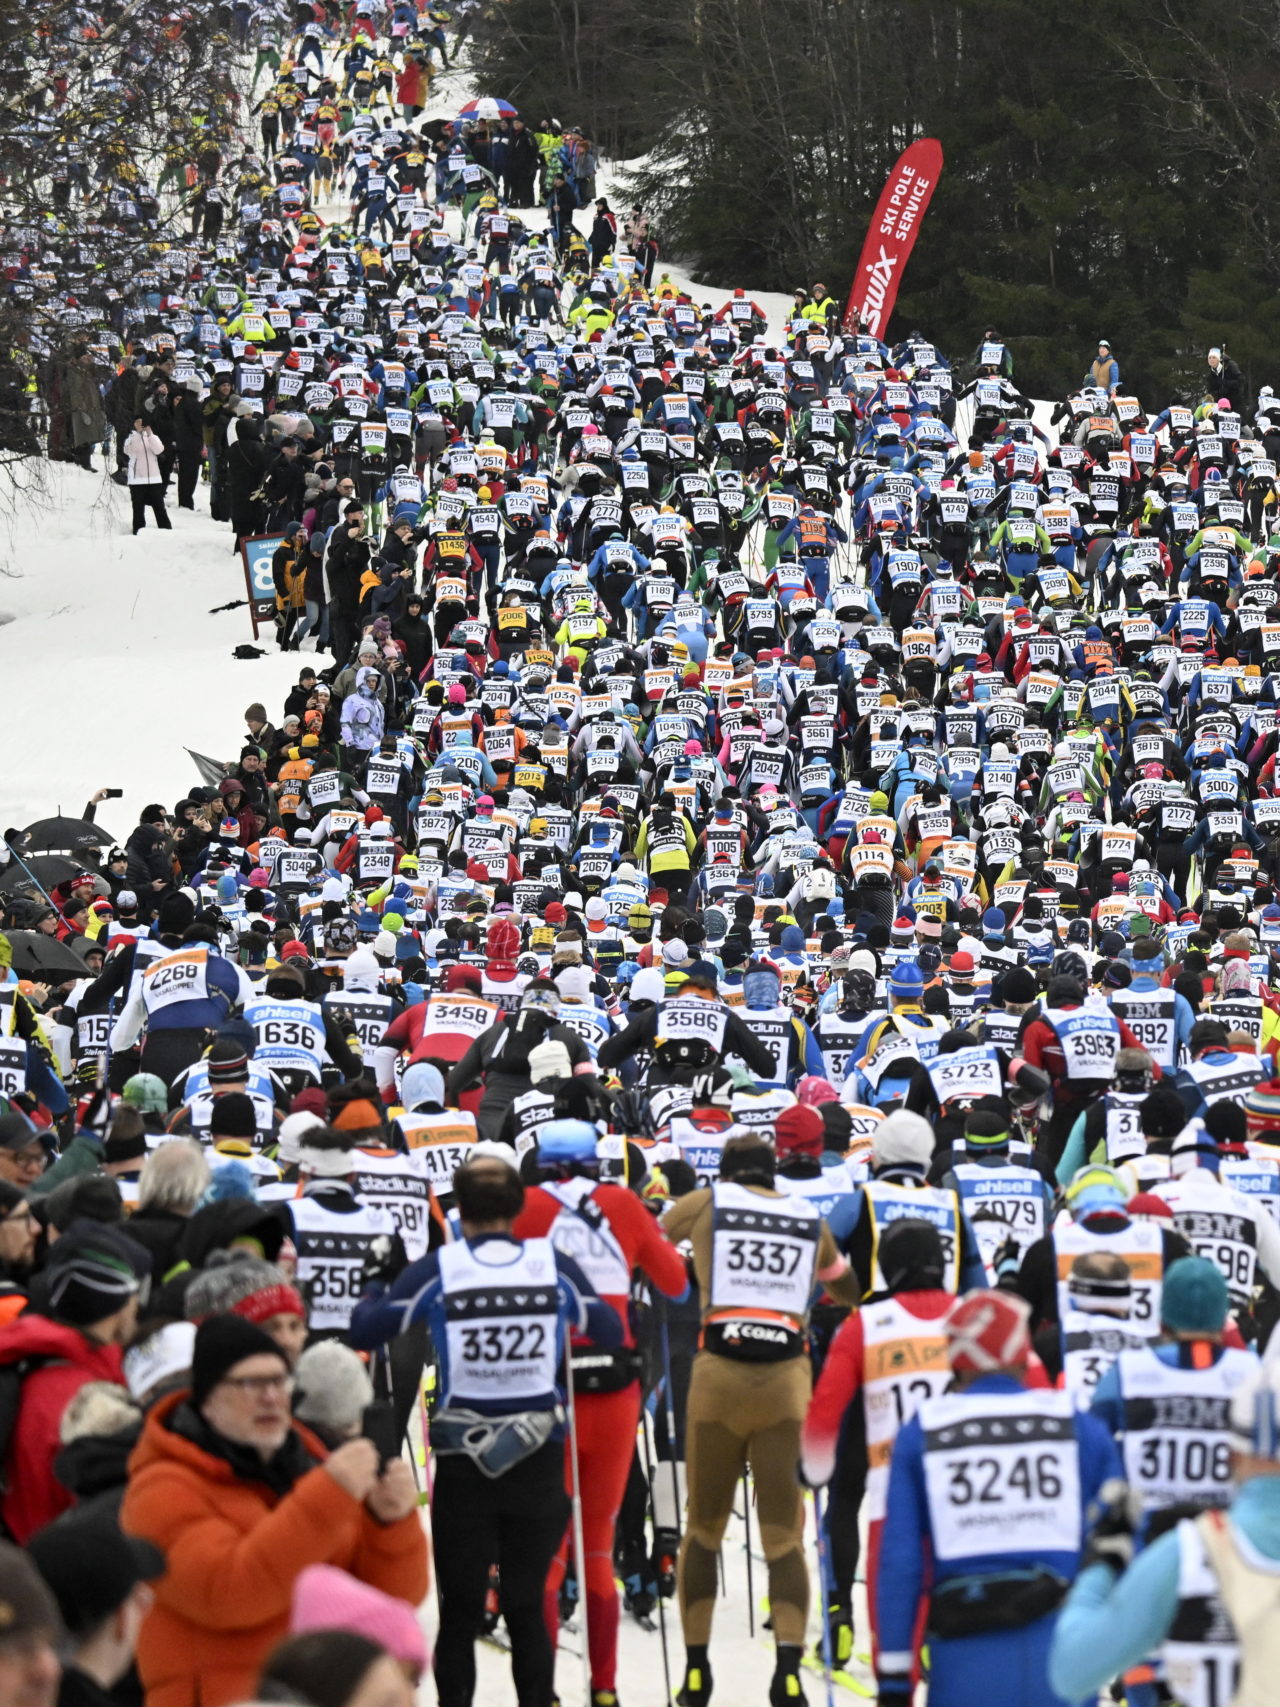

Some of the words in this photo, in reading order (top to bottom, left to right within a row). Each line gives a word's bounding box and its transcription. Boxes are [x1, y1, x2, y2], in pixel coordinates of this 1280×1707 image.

[880, 208, 898, 235] SKI
[891, 165, 915, 205] POLE
[896, 177, 929, 240] SERVICE
[762, 397, 785, 406] 3012
[816, 417, 833, 426] 2141
[1135, 447, 1153, 455] 1013
[453, 455, 473, 463] 3787
[483, 457, 504, 467] 2514
[974, 489, 995, 498] 2726
[1015, 492, 1036, 501] 2210
[439, 504, 463, 514] 10937
[596, 507, 620, 517] 2771
[945, 505, 966, 513] 4743
[475, 515, 496, 523] 4543
[1046, 517, 1069, 527] 3383
[656, 523, 677, 531] 2150
[895, 561, 920, 572] 1907
[1205, 559, 1227, 568] 2396
[441, 586, 464, 596] 2214
[650, 585, 672, 595] 1189
[937, 595, 958, 604] 1163
[501, 612, 524, 621] 2006
[677, 608, 700, 617] 4682
[750, 610, 773, 619] 3793
[1183, 610, 1206, 620] 2225
[957, 637, 980, 646] 3744
[907, 643, 932, 656] 1964
[1033, 646, 1056, 655] 1015
[707, 670, 731, 679] 2278
[1207, 684, 1230, 694] 6371
[995, 713, 1022, 726] 1670
[659, 722, 688, 731] 10451
[949, 723, 974, 734] 2262
[806, 728, 831, 738] 3661
[487, 738, 512, 749] 2064
[1136, 742, 1160, 752] 3819
[755, 763, 780, 775] 2042
[372, 772, 395, 783] 2391
[988, 773, 1013, 783] 2140
[1206, 781, 1236, 794] 3007
[420, 818, 447, 829] 3872
[712, 841, 737, 853] 1005
[989, 838, 1016, 849] 1139
[1105, 839, 1132, 851] 4774
[363, 856, 391, 866] 2348
[857, 850, 885, 861] 1114
[285, 860, 313, 871] 3048
[582, 861, 609, 872] 2067
[150, 965, 199, 990] 2268
[665, 1001, 722, 1010] stadium
[1126, 1003, 1161, 1018] IBM
[254, 1007, 312, 1021] ahlsell
[435, 1005, 488, 1024] 3458
[667, 1012, 718, 1031] 3586
[1067, 1017, 1112, 1029] ahlsell
[257, 1025, 316, 1048] 1636
[1072, 1035, 1116, 1057] 3963
[940, 1064, 994, 1079] 3723
[359, 1178, 427, 1193] stadium
[974, 1182, 1033, 1194] ahlsell
[724, 1214, 809, 1230] VOLVO
[727, 1239, 803, 1277] 3337
[453, 1294, 548, 1309] VOLVO
[461, 1325, 546, 1361] 3322
[1154, 1395, 1228, 1426] IBM
[946, 1457, 1062, 1506] 3246
